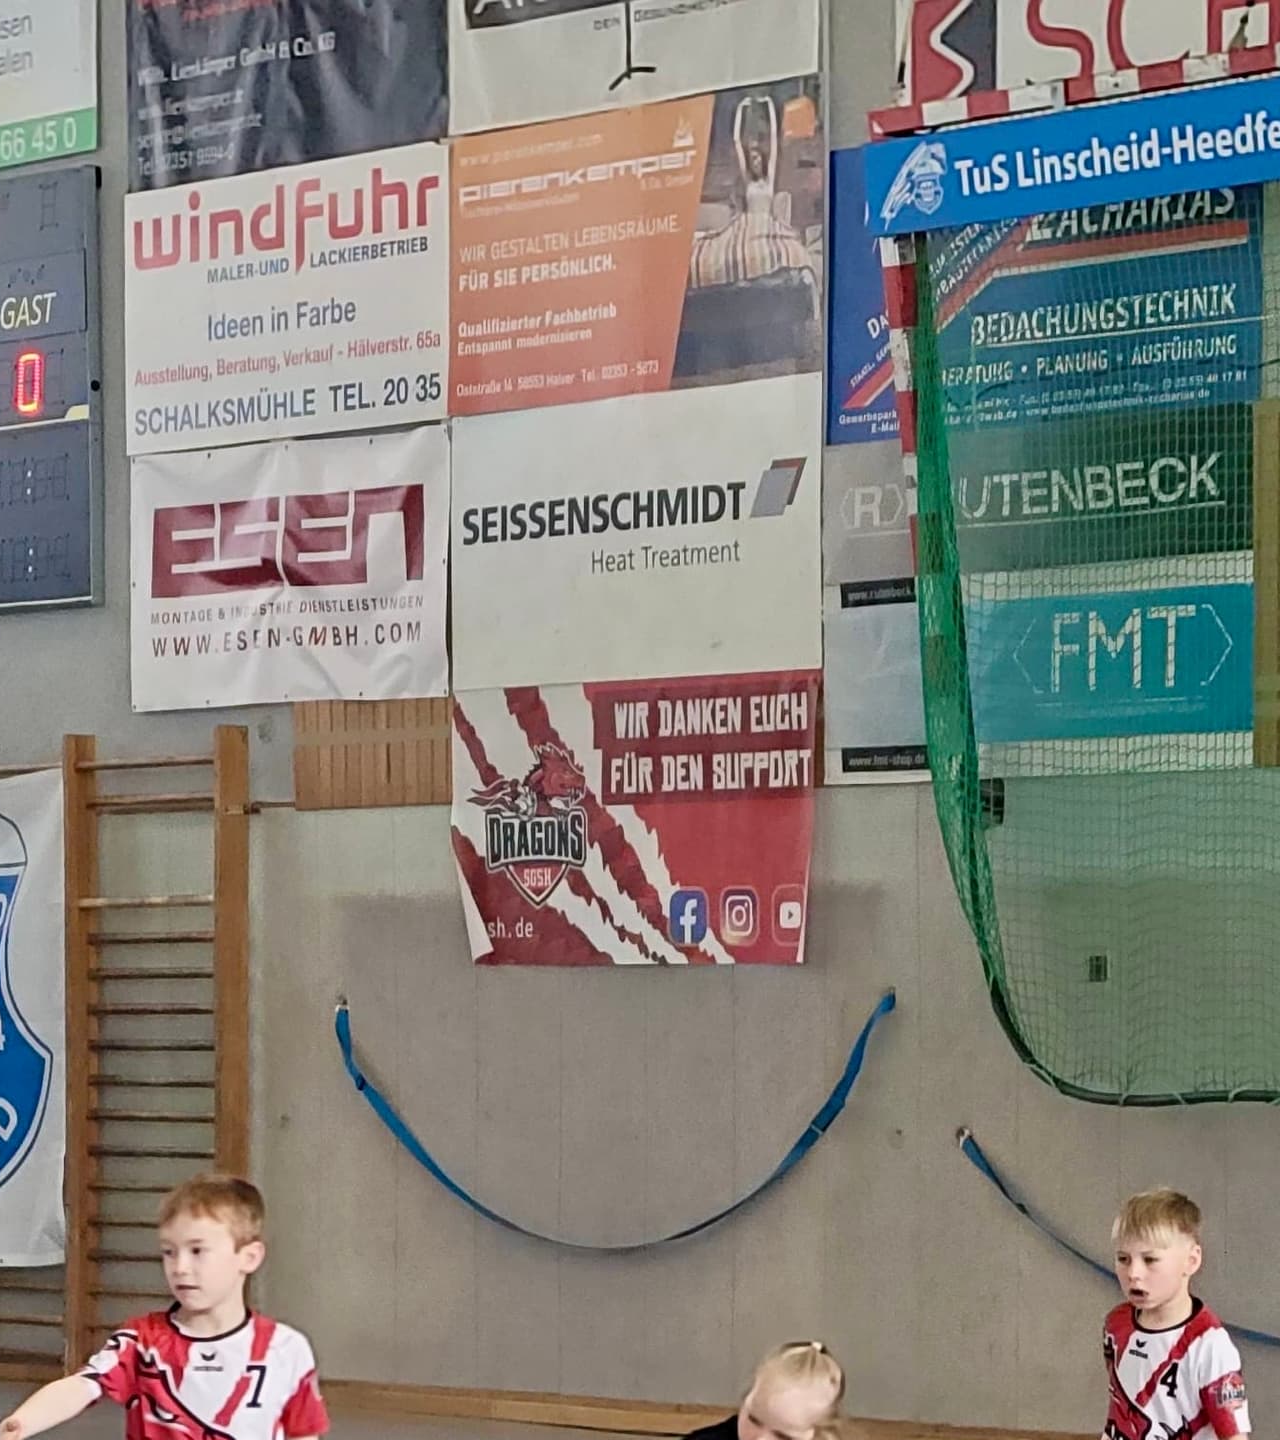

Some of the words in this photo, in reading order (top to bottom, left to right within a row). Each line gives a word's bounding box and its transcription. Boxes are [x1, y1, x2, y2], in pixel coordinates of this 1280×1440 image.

[31, 120, 58, 153] 45
[62, 117, 77, 149] 0
[953, 152, 1010, 197] TuS
[132, 167, 441, 276] windfuhr
[206, 257, 290, 285] MALER-UND
[310, 235, 429, 270] LACKIERBETRIEB
[459, 244, 487, 264] WIR
[491, 232, 570, 261] GESTALTEN
[458, 271, 489, 293] FÜR
[493, 267, 518, 289] SIE
[521, 252, 617, 285] PERSÖNLICH.
[0, 291, 58, 330] GAST
[207, 313, 264, 342] Ideen
[270, 305, 289, 333] in
[296, 296, 357, 330] Farbe
[457, 315, 542, 338] Qualifizierter
[545, 302, 617, 327] Fachbetrieb
[971, 283, 1238, 346] BEDACHUNGSTECHNIK
[134, 362, 213, 388] Ausstellung,
[216, 352, 281, 377] Beratung,
[283, 344, 335, 369] Verkauf
[416, 329, 441, 351] 65a
[457, 336, 513, 357] Entspannt
[516, 328, 593, 350] modernisieren
[1036, 349, 1109, 377] PLANUNG
[1131, 334, 1238, 367] AUSFÜHRUNG
[16, 352, 42, 414] 0
[134, 387, 317, 437] SCHALKSMÜHLE
[328, 382, 376, 413] TEL.
[382, 376, 409, 407] 20
[414, 372, 442, 402] 35
[462, 480, 747, 547] SEISSENSCHMIDT
[590, 549, 636, 576] Heat
[640, 538, 742, 571] Treatment
[150, 608, 213, 625] MONTAGE
[298, 595, 425, 615] DIENSTLEISTUNGEN
[151, 620, 422, 658] WWW.ESEN-GMBH.COM
[1049, 602, 1198, 695] FMT
[613, 700, 650, 740] WIR
[657, 696, 743, 738] DANKEN
[749, 690, 809, 734] EUCH
[609, 752, 654, 794] FÜR
[660, 754, 705, 793] DEN
[712, 749, 813, 792] SUPPORT
[487, 810, 586, 866] DRAGONS
[245, 1364, 267, 1409] 7
[1159, 1362, 1180, 1399] 4
